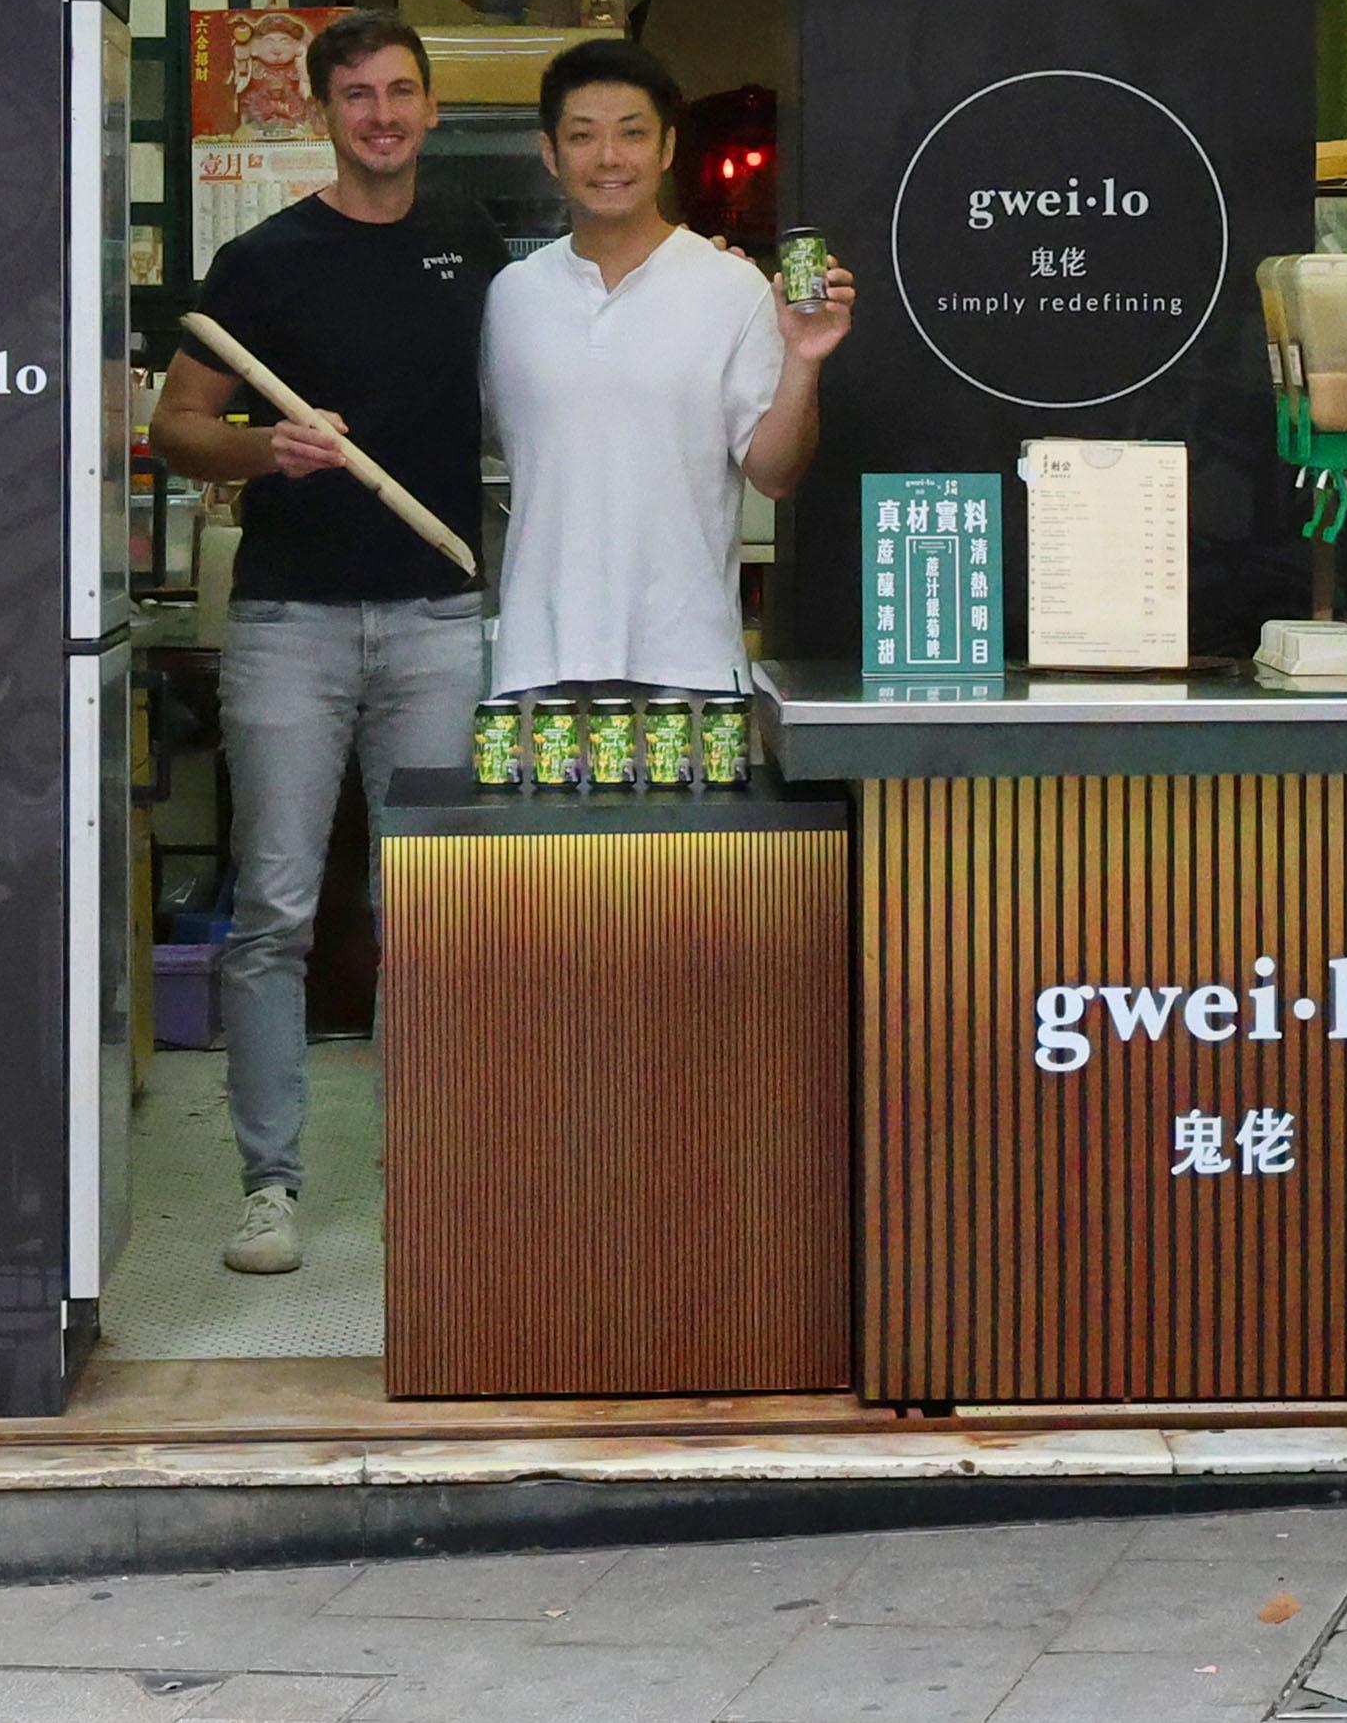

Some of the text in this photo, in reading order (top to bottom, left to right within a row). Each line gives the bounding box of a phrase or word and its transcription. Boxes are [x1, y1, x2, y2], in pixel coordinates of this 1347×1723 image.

[1029, 247, 1088, 278] 鬼佬
[937, 292, 1184, 316] simply redefining
[876, 499, 989, 534] 真材實料
[970, 538, 989, 665] 清熱明目
[1170, 1108, 1296, 1176] 鬼佬
